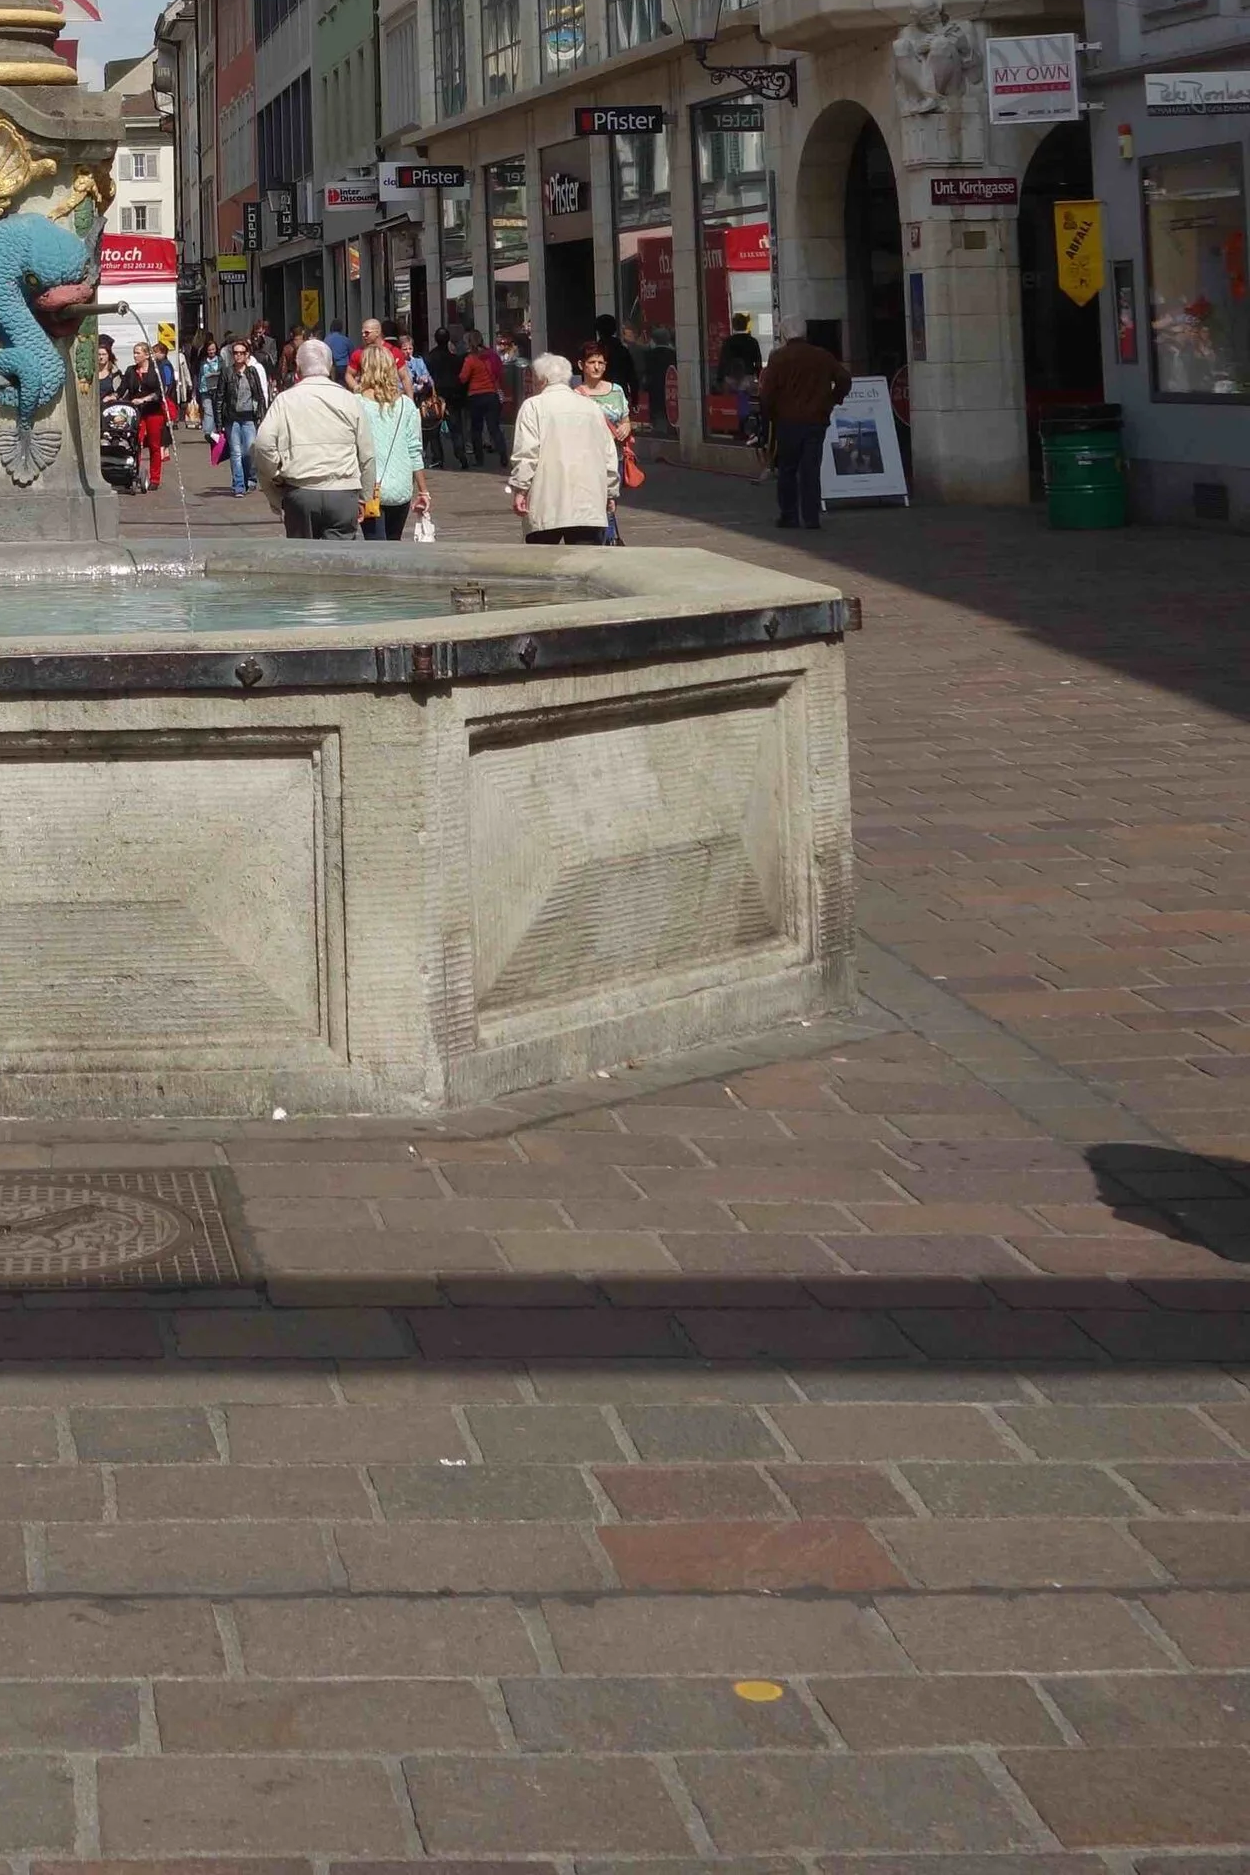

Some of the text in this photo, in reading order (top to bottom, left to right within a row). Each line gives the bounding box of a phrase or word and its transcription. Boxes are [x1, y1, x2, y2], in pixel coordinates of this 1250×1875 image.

[995, 64, 1069, 83] MY OWN
[594, 111, 656, 131] Pfister
[412, 169, 460, 185] Pfister
[340, 188, 361, 196] Inter
[550, 173, 579, 215] Pfister
[934, 180, 1015, 198] Unt. Kirchgasse
[248, 205, 257, 248] DEPOT
[1065, 221, 1094, 260] ABFALL
